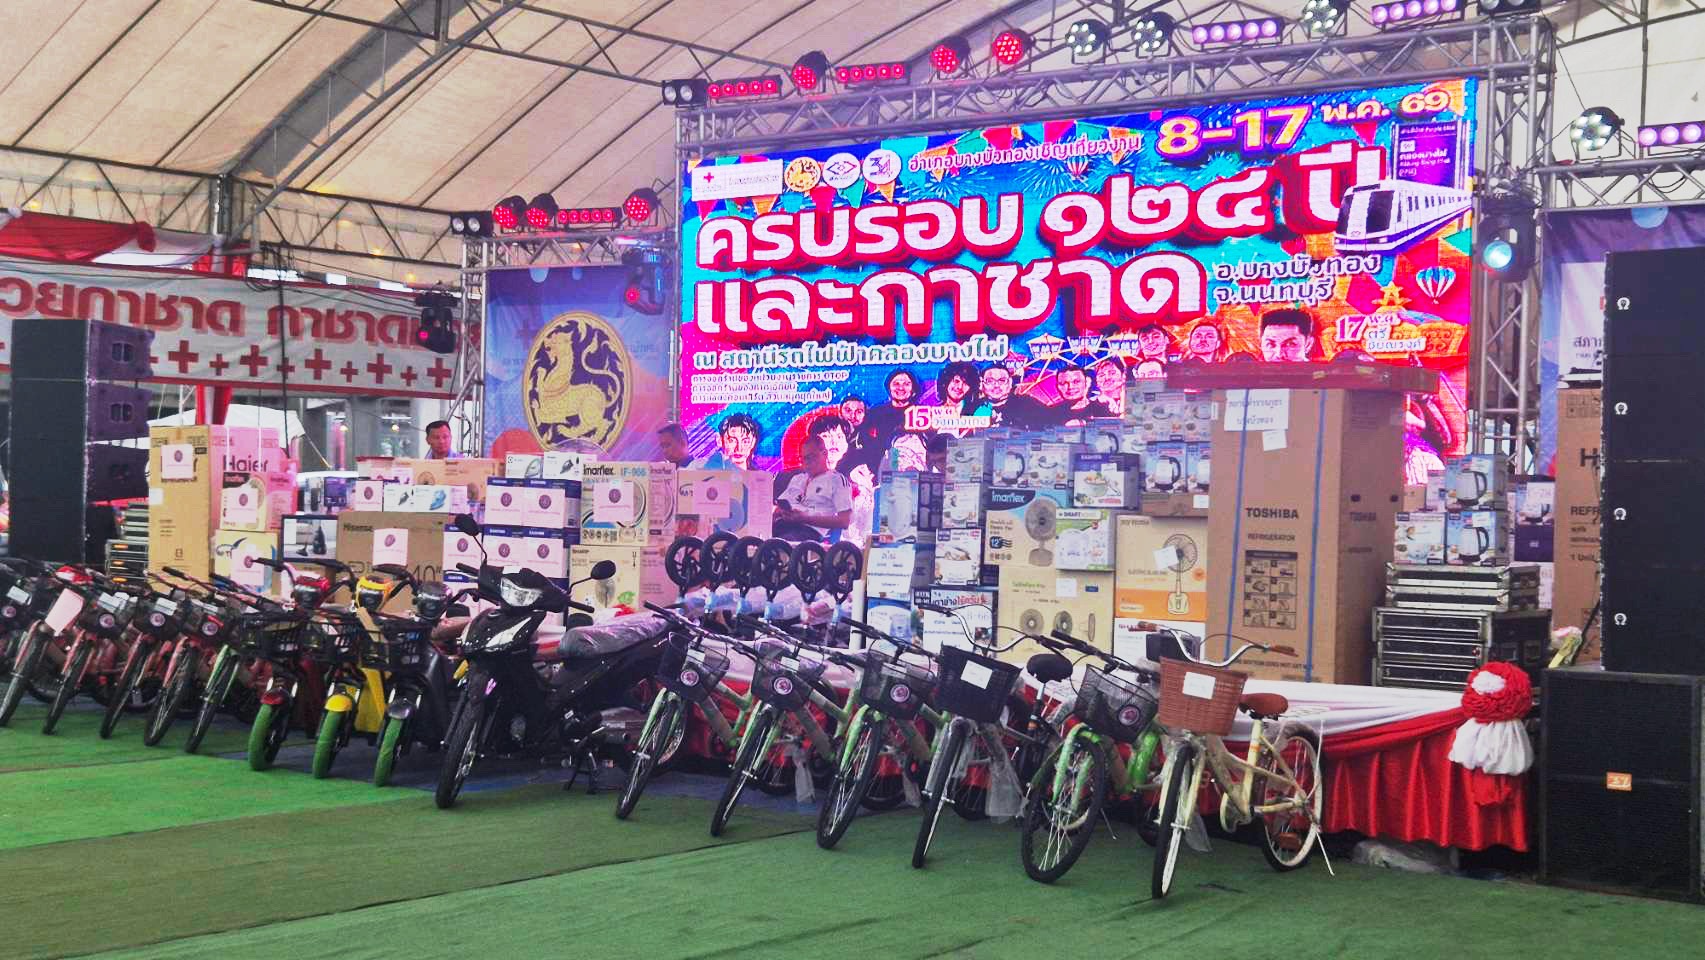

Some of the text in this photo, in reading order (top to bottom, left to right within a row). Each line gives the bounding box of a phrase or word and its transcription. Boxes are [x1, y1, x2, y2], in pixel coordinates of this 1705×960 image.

[1321, 99, 1390, 122] พ.ค.
[1402, 90, 1450, 113] 69
[909, 135, 1140, 171] อำเภอบางบัวทองเชิญเที่ยวงาน
[698, 194, 1021, 266] ครบรอบ
[1044, 170, 1268, 247] ๑๒๔
[1216, 254, 1380, 279] อ.บางบัวทอง
[696, 254, 1198, 333] และกาชาด
[1216, 278, 1331, 305] จ.นนทบุรี
[1339, 316, 1366, 340] 17
[695, 336, 1008, 367] ณ สถานีรถไฟฟ้าคลองบางไผ่
[823, 371, 848, 380] OTOP
[907, 407, 930, 427] 15
[223, 455, 268, 472] Haier
[1246, 508, 1299, 519] TOSHIBA
